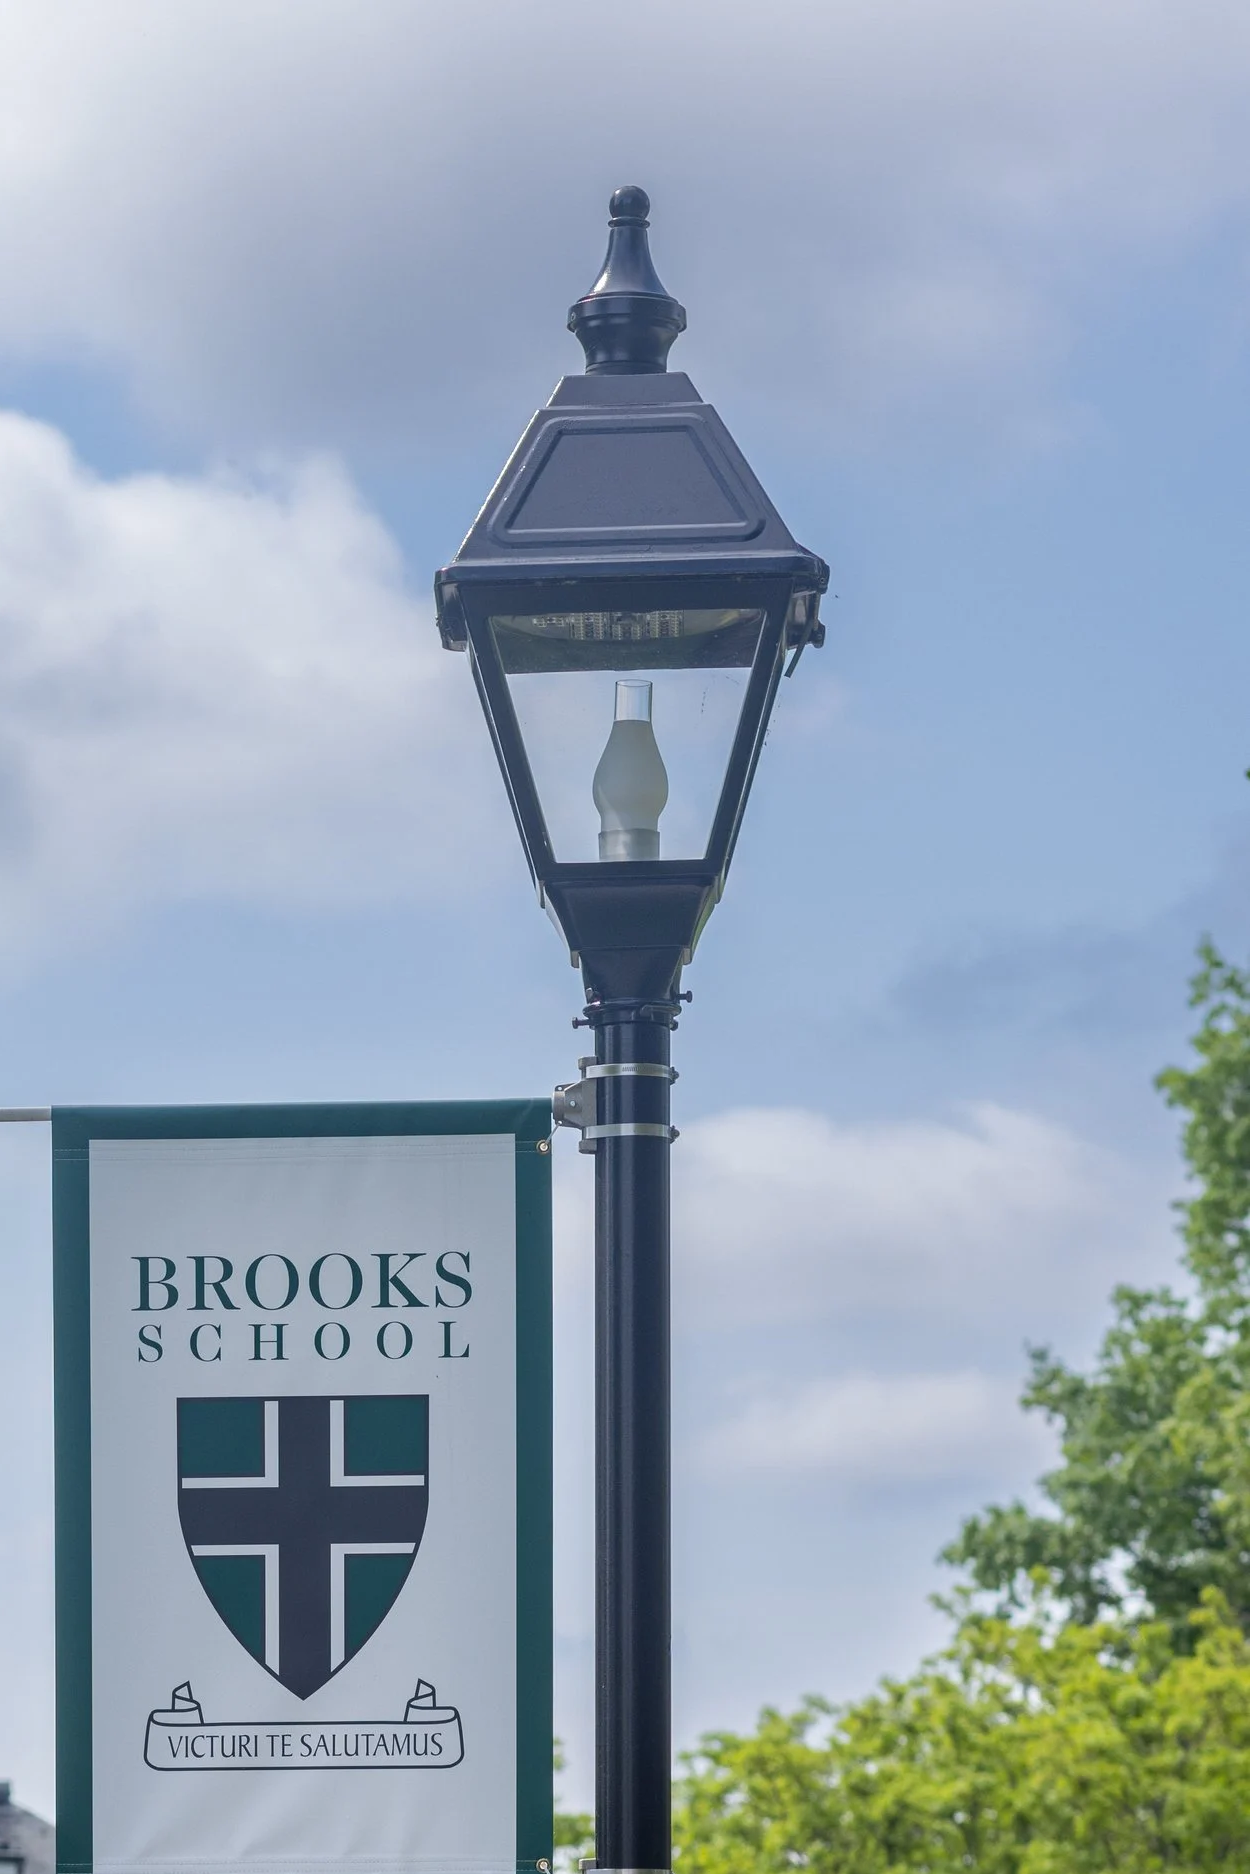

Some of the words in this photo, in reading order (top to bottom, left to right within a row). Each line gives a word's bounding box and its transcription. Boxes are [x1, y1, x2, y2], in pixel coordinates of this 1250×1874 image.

[130, 1250, 473, 1312] BROOKS
[137, 1320, 470, 1363] SCHOOL
[167, 1733, 259, 1759] VICTURI
[266, 1733, 293, 1758] TE
[300, 1731, 443, 1758] SALUTAMUS
